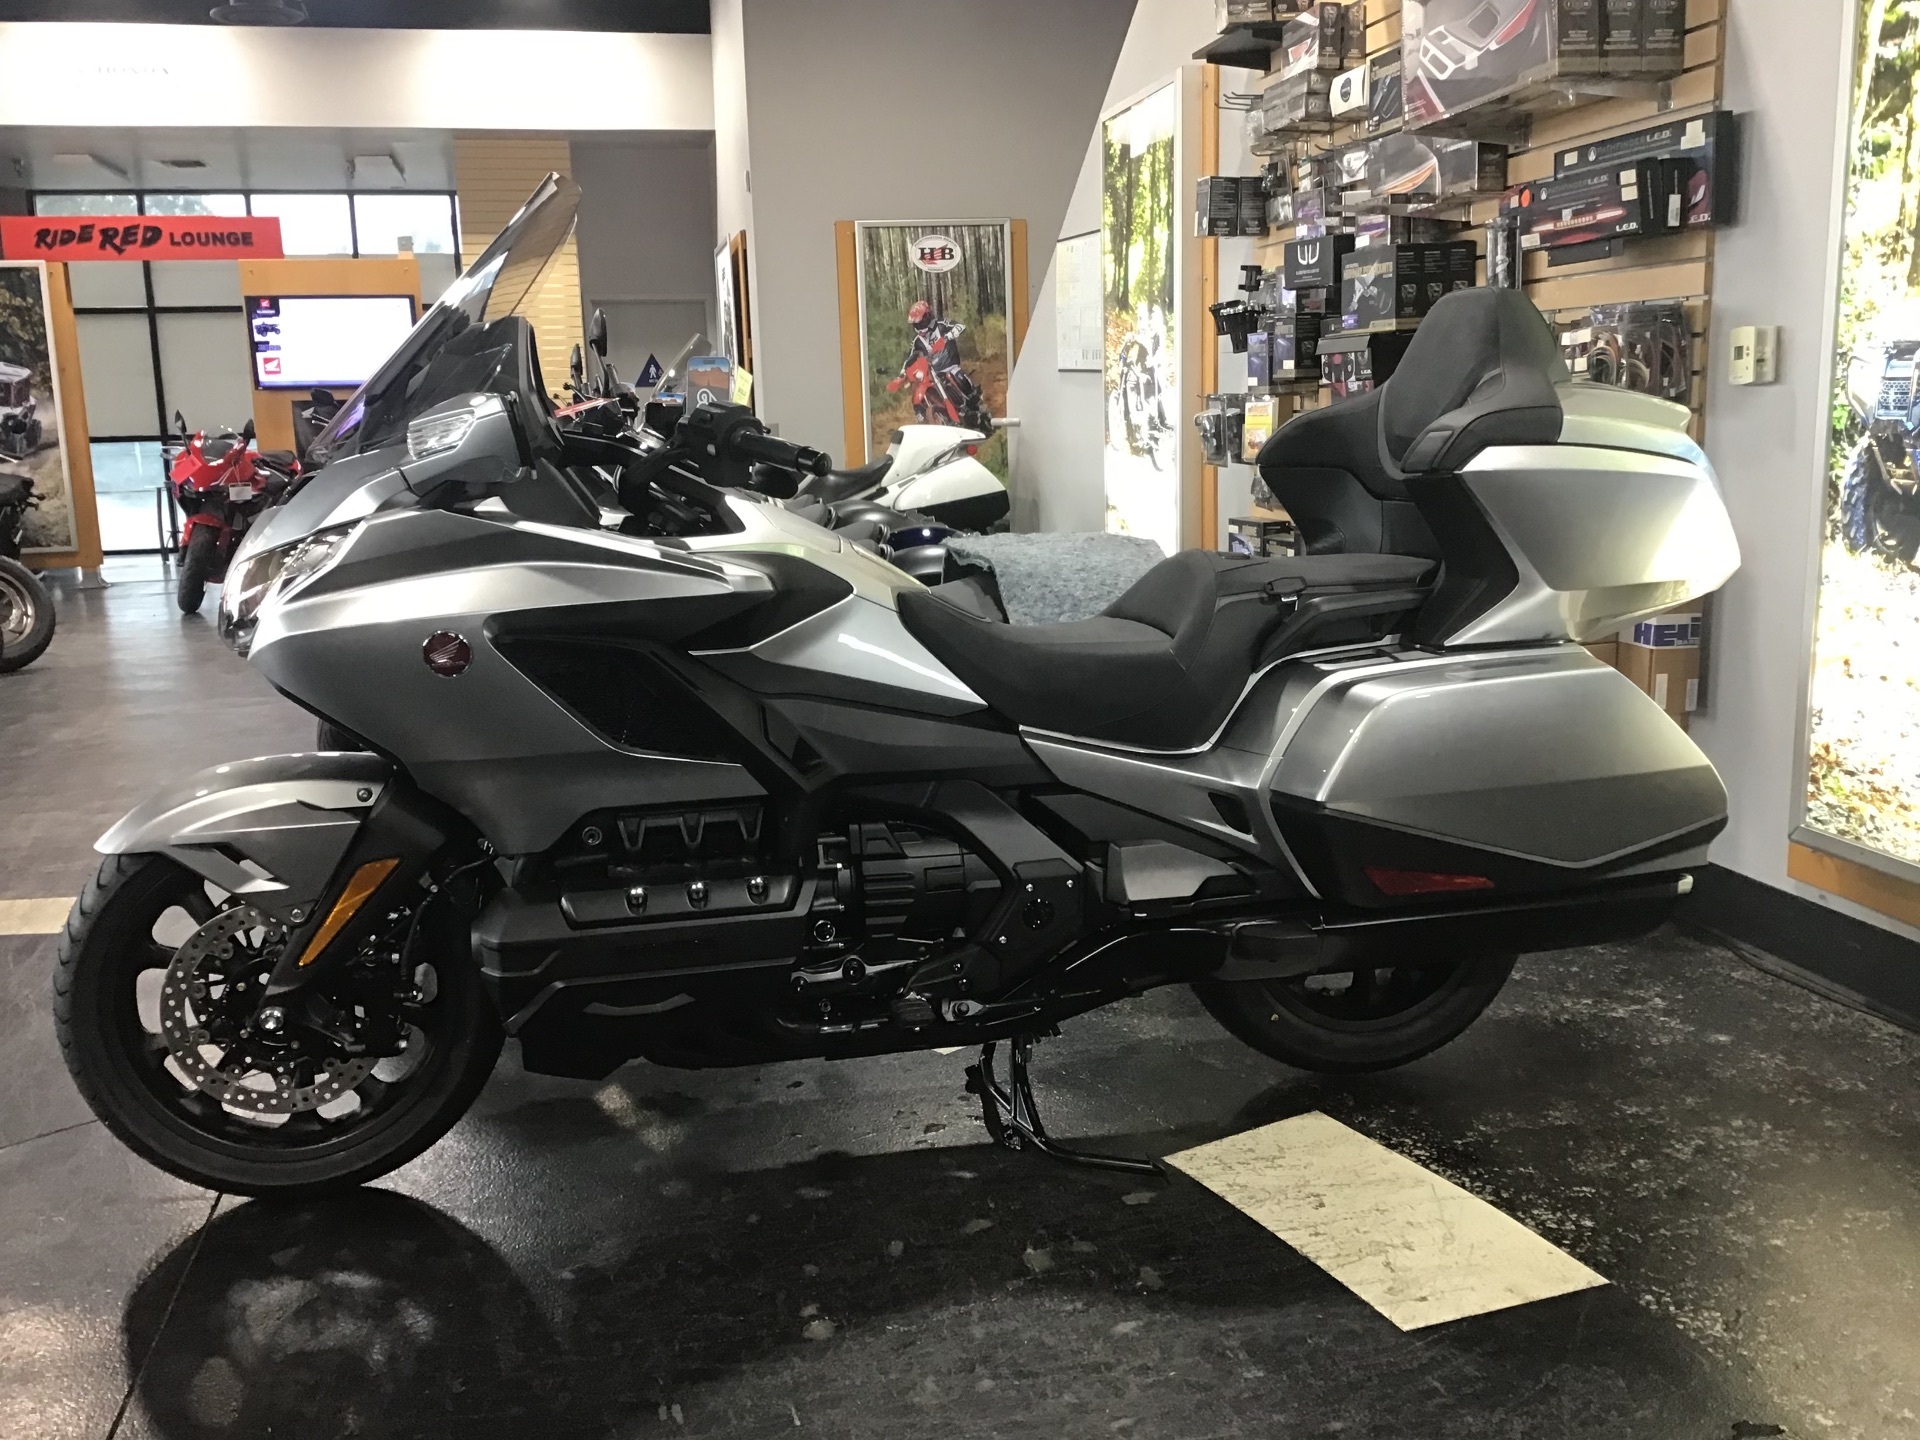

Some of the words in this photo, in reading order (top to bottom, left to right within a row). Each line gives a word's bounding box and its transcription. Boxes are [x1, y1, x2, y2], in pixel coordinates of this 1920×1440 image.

[34, 224, 95, 250] RIDE
[98, 223, 162, 255] RED
[169, 231, 254, 246] LOUNGE
